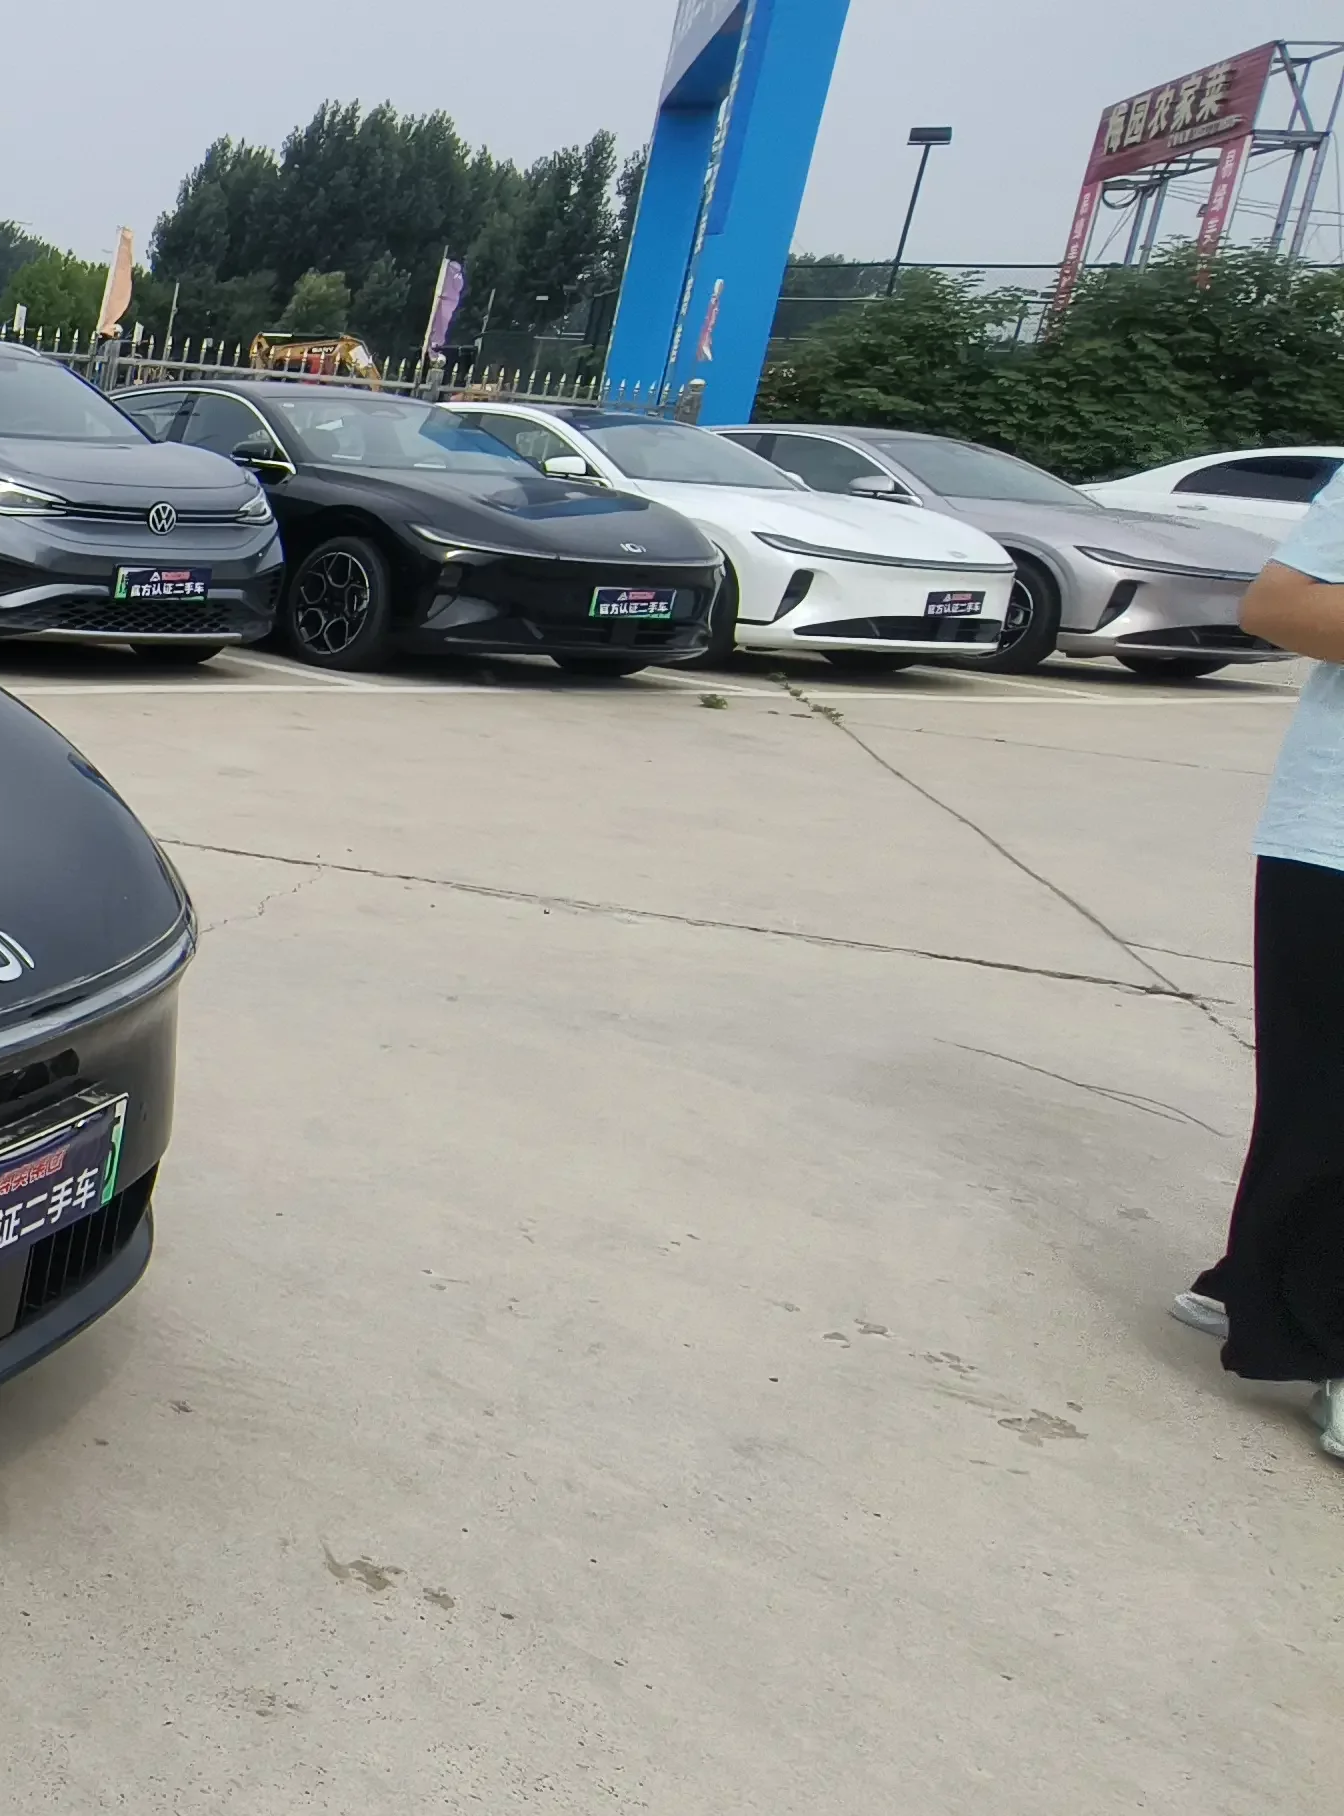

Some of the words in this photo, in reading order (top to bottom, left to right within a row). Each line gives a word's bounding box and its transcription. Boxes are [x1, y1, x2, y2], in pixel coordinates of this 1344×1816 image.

[131, 582, 204, 597] 官方认证二手车
[599, 601, 669, 615] 官方认证二手车
